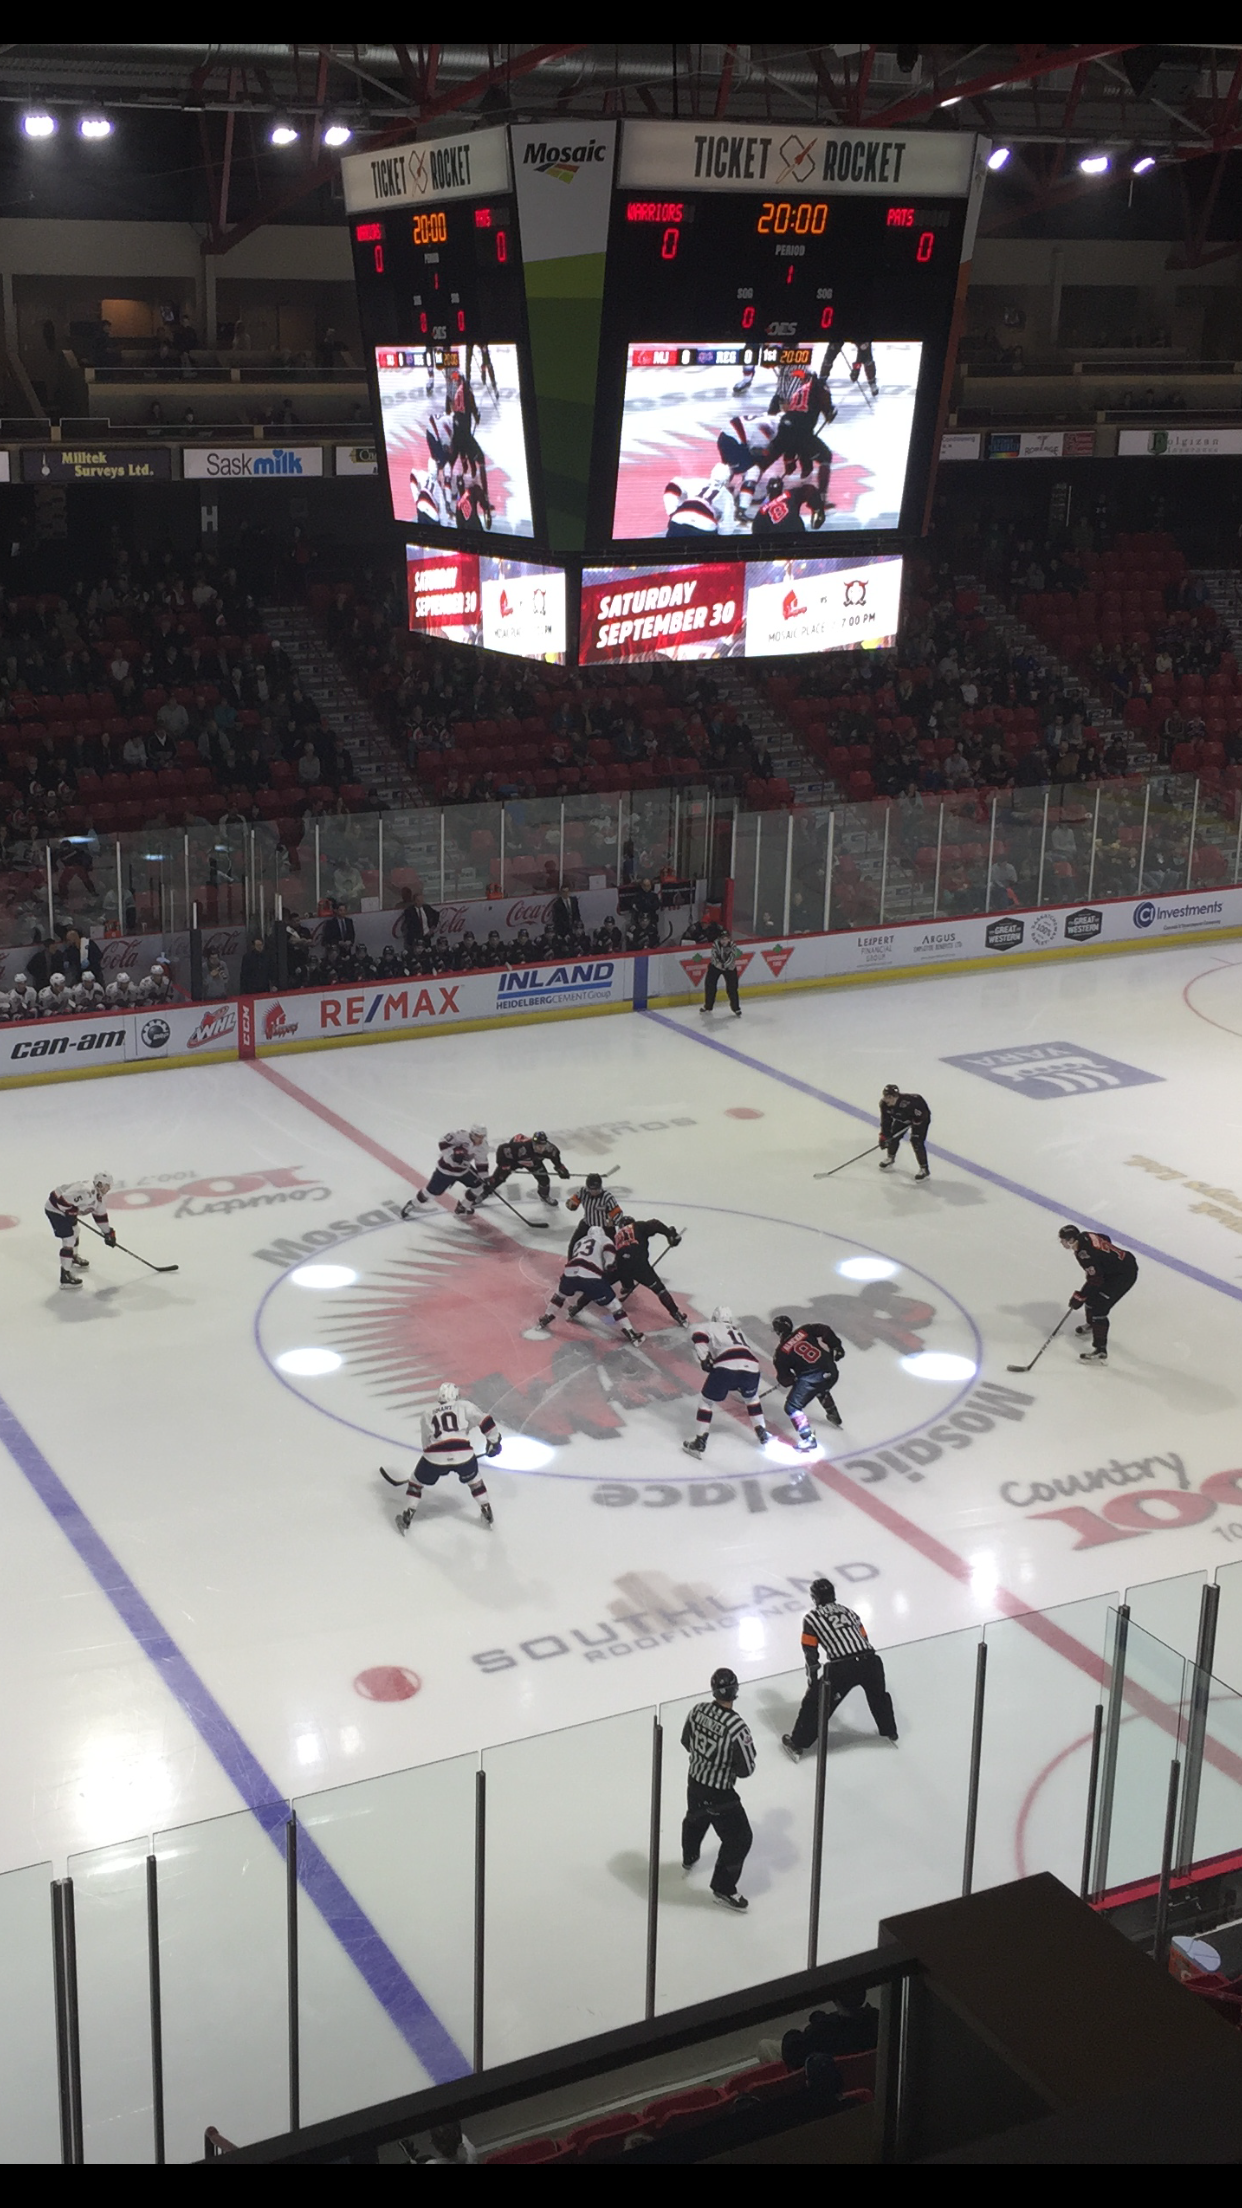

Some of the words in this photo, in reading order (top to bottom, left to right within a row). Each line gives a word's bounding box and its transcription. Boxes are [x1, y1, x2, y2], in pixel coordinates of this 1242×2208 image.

[523, 139, 606, 164] Mosaic
[694, 135, 772, 179] TICKET
[823, 140, 906, 182] ROCKET
[371, 157, 407, 199] TICKET
[430, 145, 471, 190] ROCKET
[627, 203, 683, 224] WARRIORS
[757, 203, 828, 234] 20:00
[887, 208, 914, 227] PATS
[413, 212, 447, 245] 20:00
[661, 228, 679, 260] 0
[775, 244, 805, 256] PERIOD
[917, 232, 934, 262] 0
[787, 265, 794, 284] 1
[737, 287, 753, 299] SOG
[816, 287, 833, 299] SOG
[742, 306, 755, 328] 0
[821, 306, 834, 328] 0
[653, 351, 670, 365] MJ
[681, 350, 690, 364] 0
[743, 350, 752, 365] 0
[780, 349, 809, 363] 20:00
[62, 452, 107, 465] Milltek
[75, 464, 125, 479] Surveys
[128, 463, 154, 477] Ltd.
[465, 591, 477, 613] 30
[597, 580, 698, 620] SATURDAY
[596, 606, 707, 649] SEPTEMBER
[712, 600, 736, 625] 30
[863, 611, 876, 624] PM
[1073, 915, 1096, 925] GREAT
[1157, 901, 1222, 920] Investments
[921, 933, 956, 945] ARGUS
[988, 932, 1021, 944] WESTERN
[994, 925, 1017, 934] GREAT
[1067, 923, 1100, 934] WESTERN
[498, 962, 614, 992] INLAND
[320, 986, 460, 1028] RE/MAX
[496, 991, 588, 1010] HEIDELBERGCEMENT
[195, 1012, 237, 1041] WHL
[11, 1029, 126, 1060] can-am
[965, 1047, 1073, 1066] YARA
[174, 1186, 332, 1219] Country
[573, 1239, 596, 1258] 23
[793, 1339, 822, 1364] 8
[431, 1411, 459, 1438] 10
[844, 1381, 1036, 1484] Mosaic
[1000, 1452, 1191, 1508] Country
[591, 1471, 822, 1513] Place
[471, 1560, 881, 1674] SOUTHLAND
[828, 1613, 852, 1628] 24
[584, 1615, 742, 1664] ROOFING
